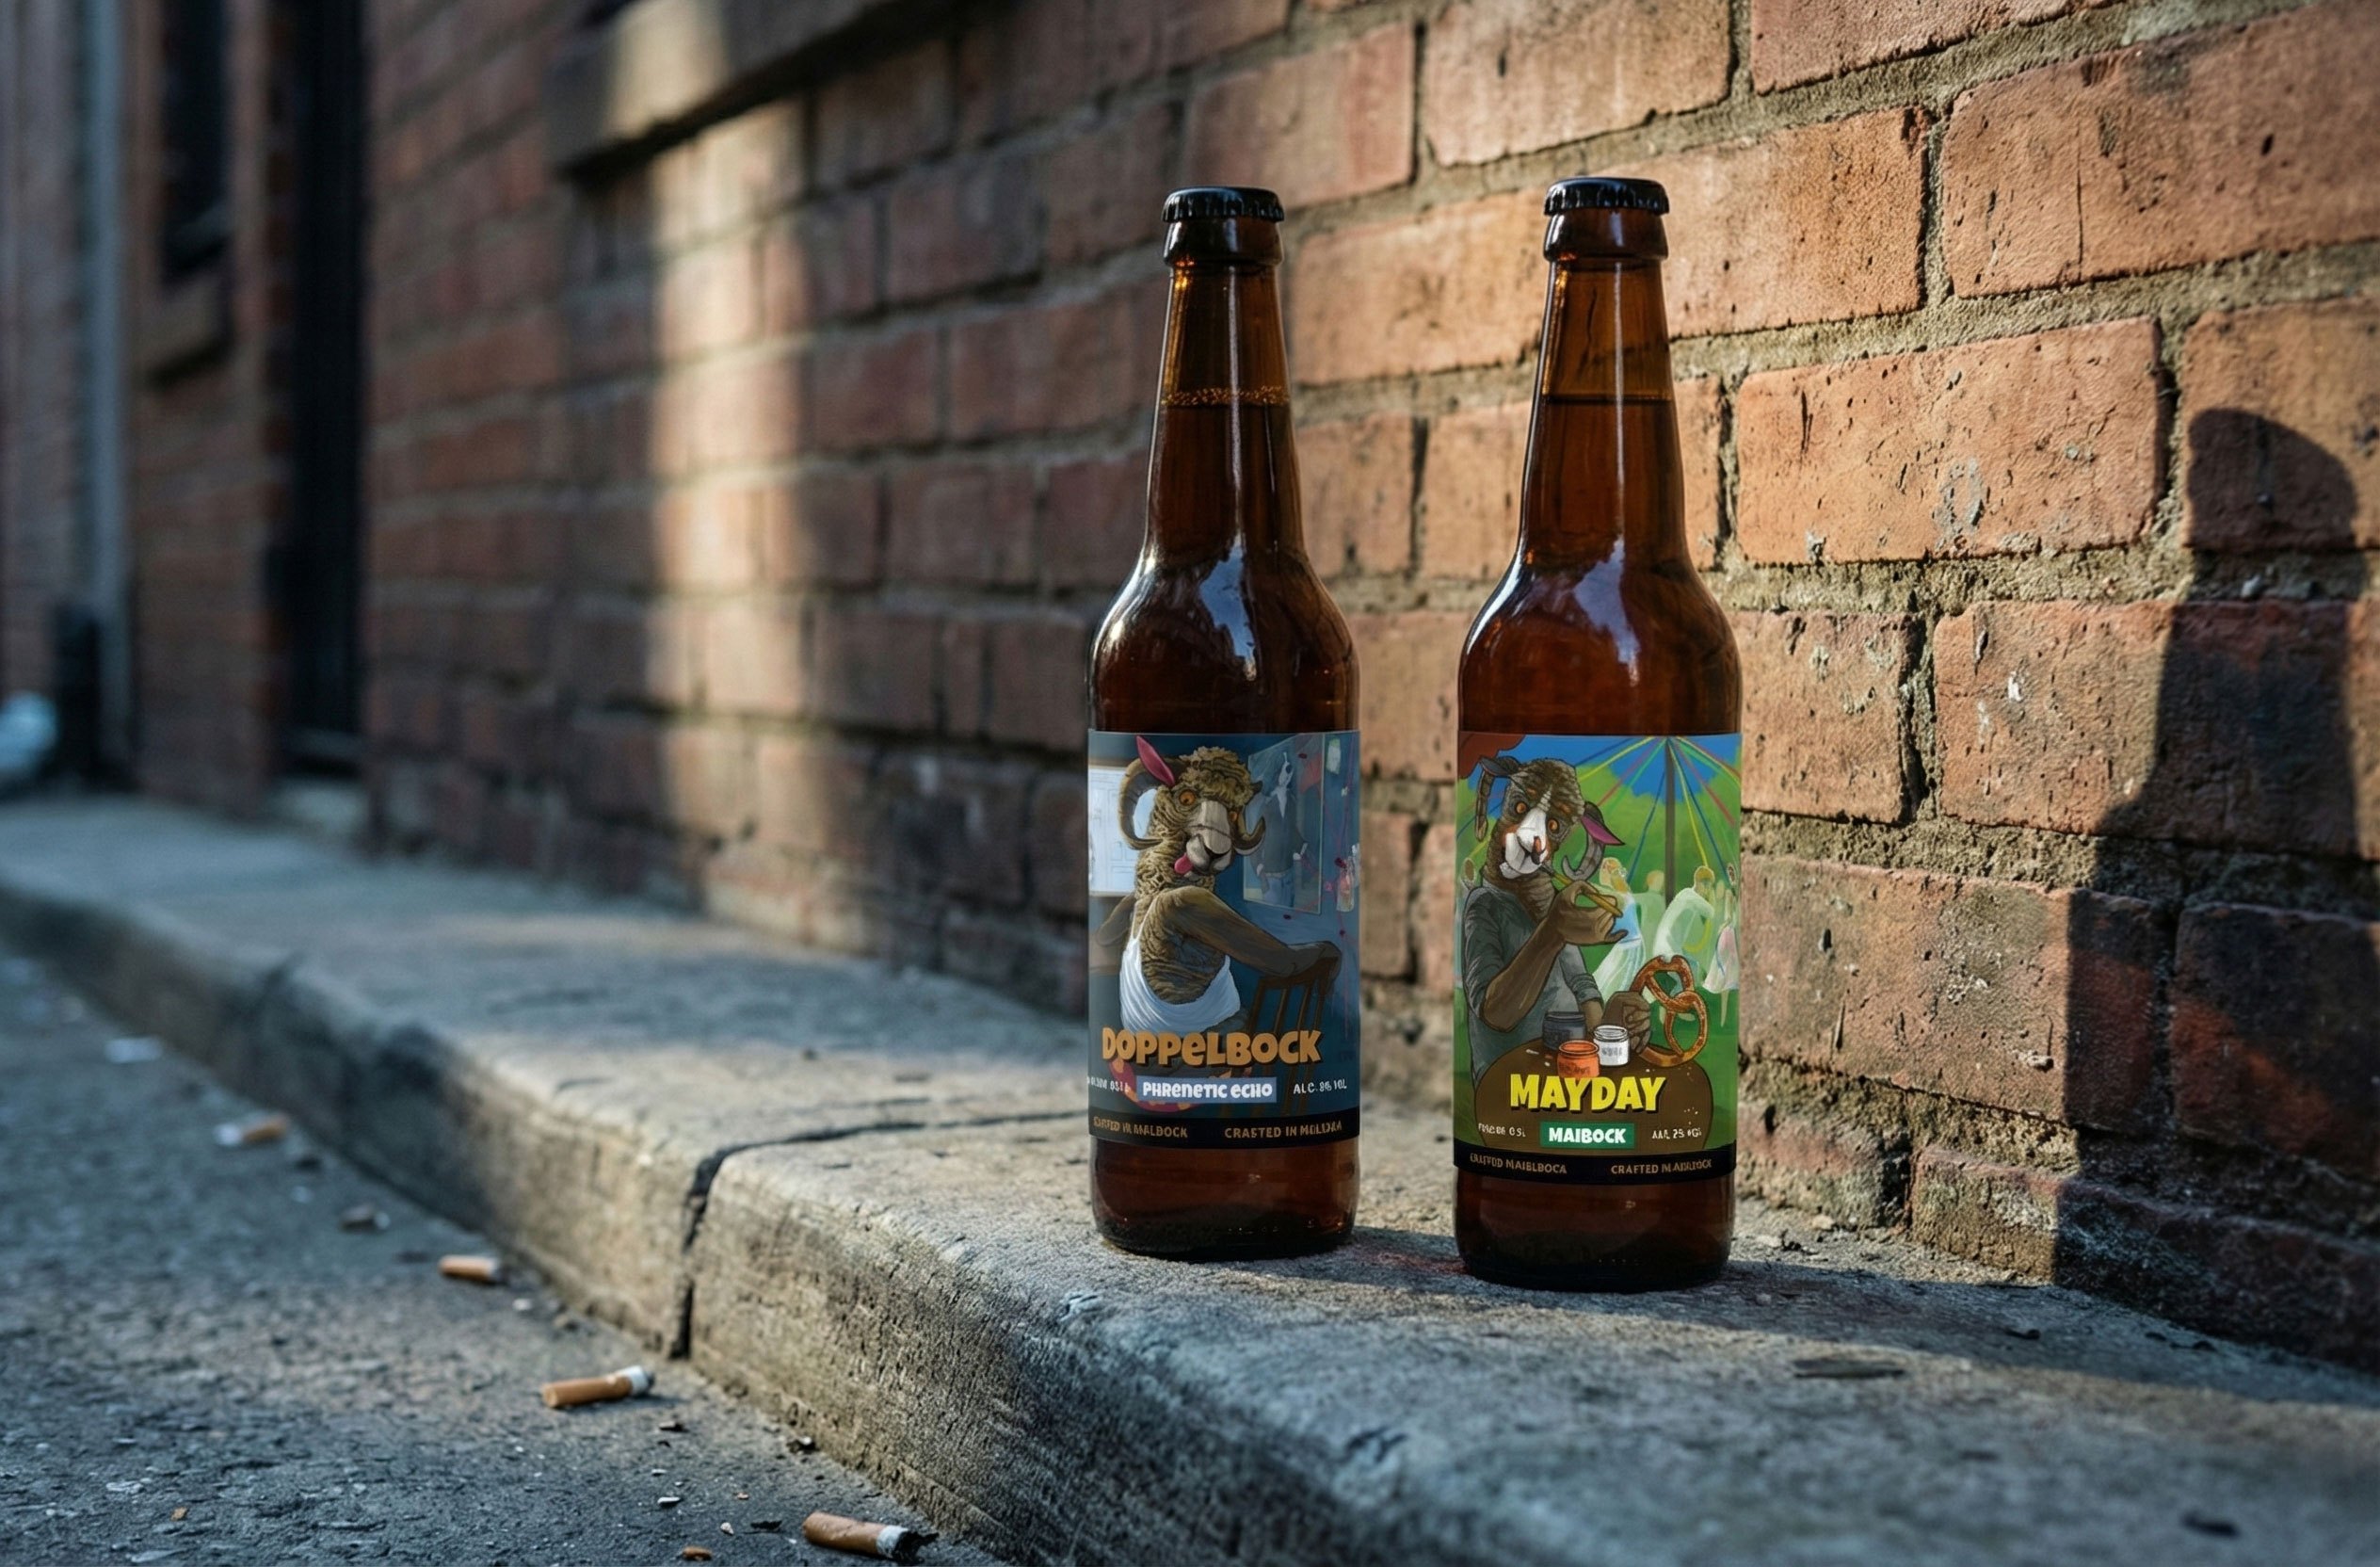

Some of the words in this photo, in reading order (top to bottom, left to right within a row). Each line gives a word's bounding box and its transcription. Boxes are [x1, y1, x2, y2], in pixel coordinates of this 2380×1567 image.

[1510, 1074, 1666, 1112] MAYDAY
[1549, 1126, 1627, 1144] MAIBOCK
[1611, 1164, 1658, 1175] CRAFTED
